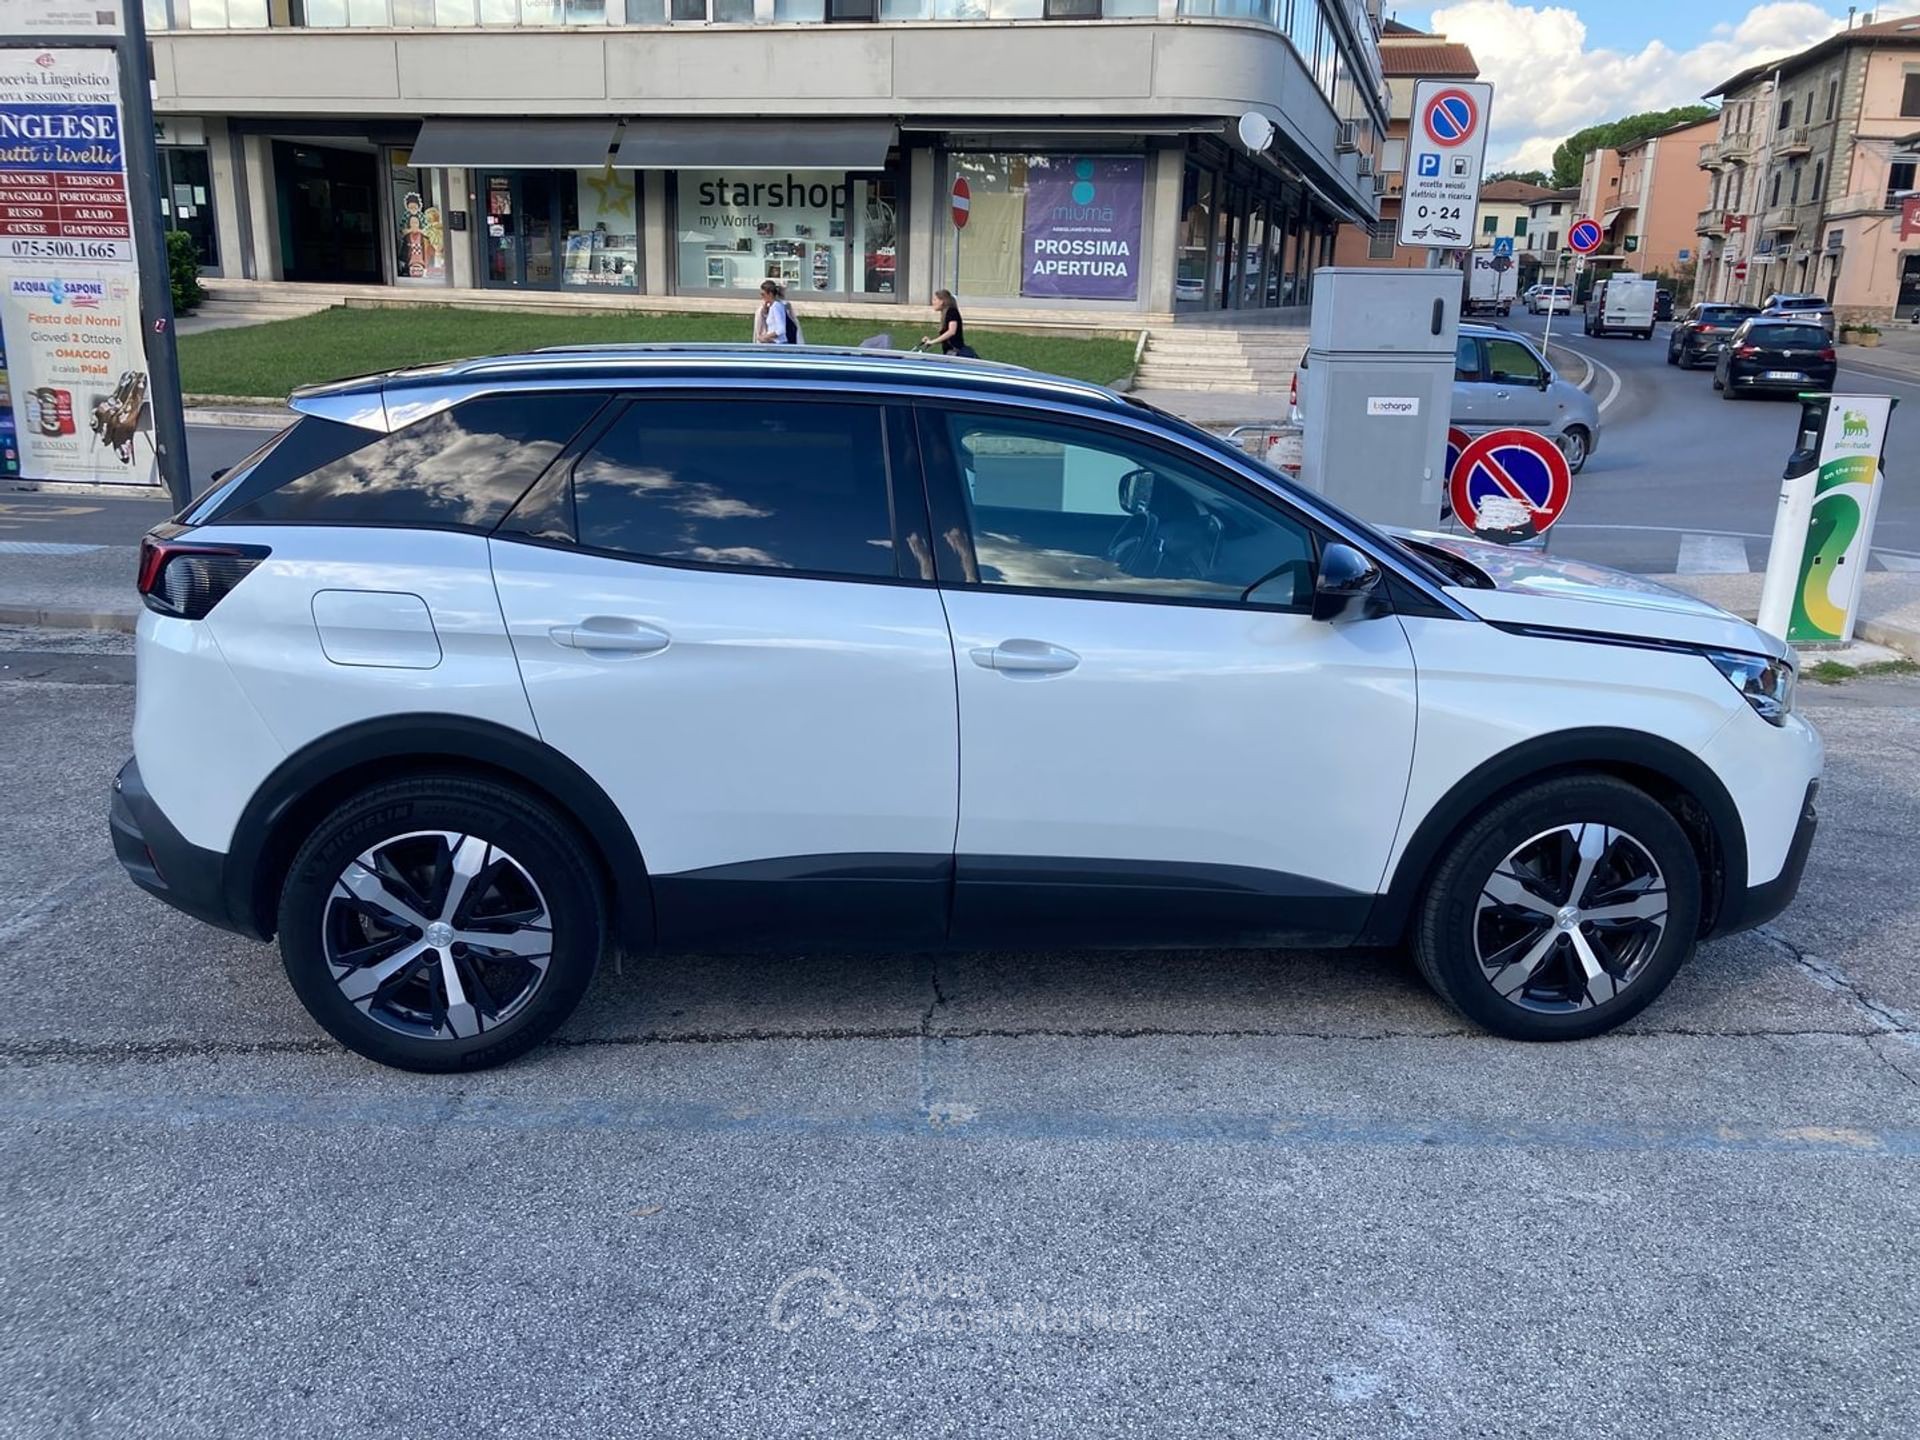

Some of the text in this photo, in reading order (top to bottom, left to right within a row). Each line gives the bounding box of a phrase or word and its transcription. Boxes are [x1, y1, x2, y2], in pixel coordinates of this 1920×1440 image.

[41, 72, 110, 88] Linguistico
[24, 92, 73, 102] SESSIONE
[0, 114, 116, 139] NGLESE
[43, 147, 54, 162] i
[55, 144, 120, 164] livelli
[64, 175, 115, 186] TEDESCO
[1445, 181, 1466, 190] veicoli
[60, 191, 125, 203] PORTOGHESE
[699, 173, 846, 218] starshop
[1411, 190, 1472, 200] elettrici in ricarica
[7, 207, 113, 219] RUSSO ARABO
[1050, 206, 1113, 222] miuma
[1418, 205, 1428, 218] 0
[1440, 206, 1460, 219] 24
[699, 213, 760, 229] my World
[7, 223, 128, 236] CINESE GIAPPONESE
[12, 240, 116, 258] 075-500.1665
[1034, 239, 1130, 256] PROSSIMA
[1032, 260, 1128, 277] APERTURA
[13, 281, 48, 293] ACQUA
[63, 283, 103, 295] SAPONE
[28, 312, 121, 327] Festa dei Nonni
[71, 333, 80, 343] 2
[81, 333, 122, 345] Ottobre
[55, 348, 110, 360] OMAGGIO
[80, 364, 108, 374] Plaid
[1823, 471, 1834, 480] on
[1836, 466, 1849, 476] the
[322, 804, 411, 862] MICHELIN
